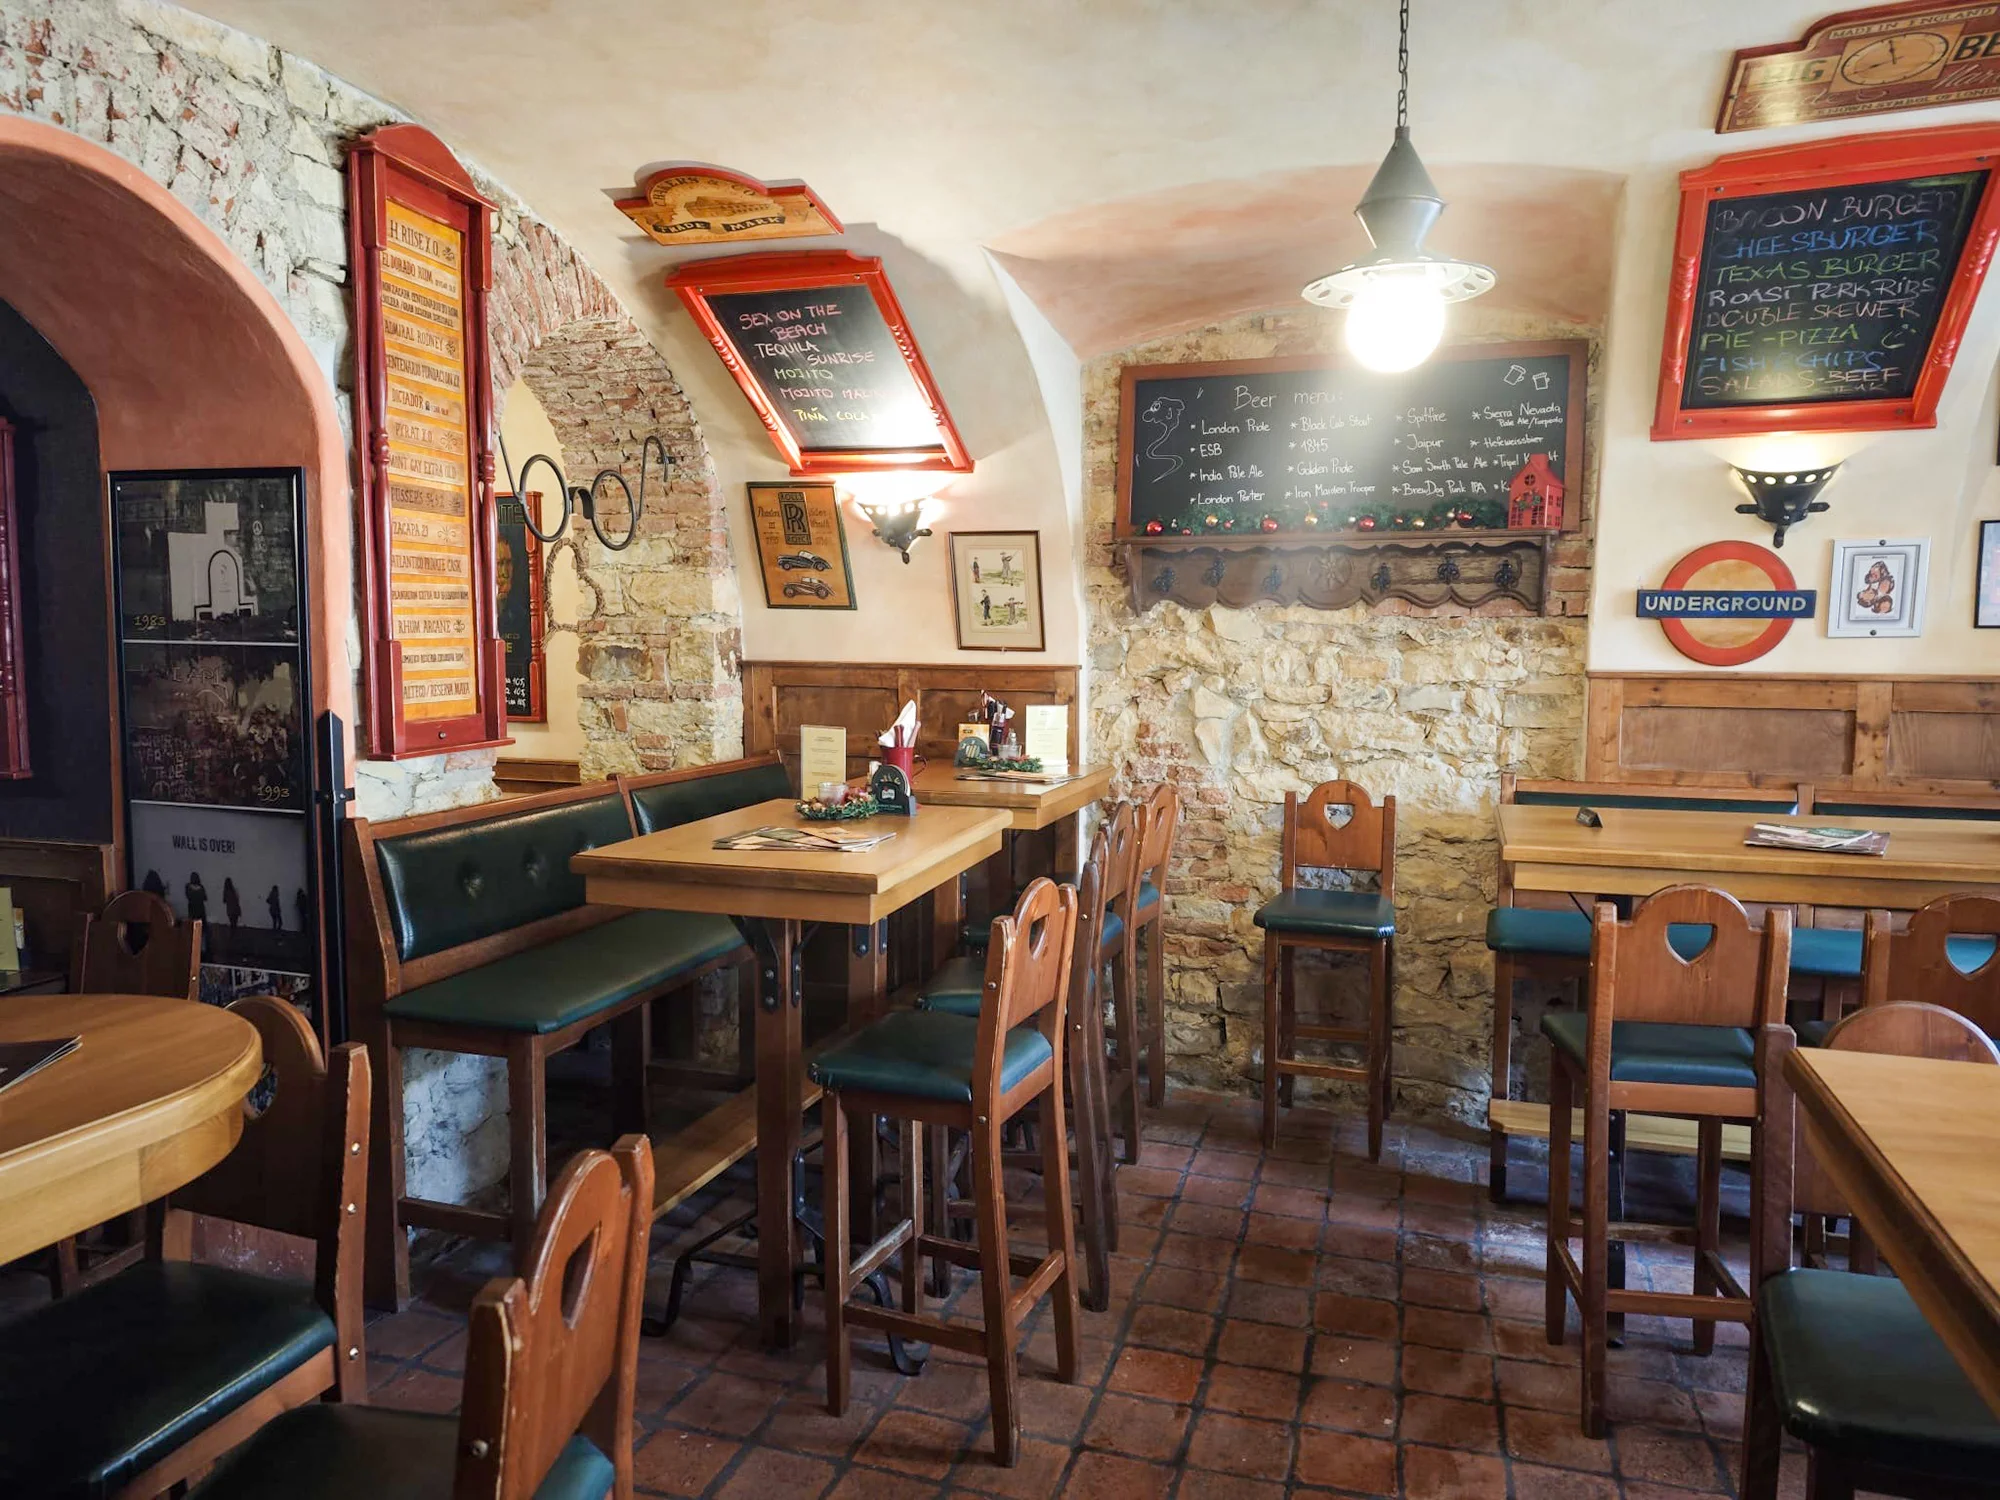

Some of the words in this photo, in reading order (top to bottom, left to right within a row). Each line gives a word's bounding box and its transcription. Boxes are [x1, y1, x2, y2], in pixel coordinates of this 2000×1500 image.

[1832, 26, 1873, 39] MADE
[1877, 22, 1898, 32] IN
[1905, 8, 1993, 26] ENGLAND
[661, 222, 707, 233] TRADE
[730, 216, 781, 231] MARK
[1713, 260, 1813, 286] TEXAS
[1814, 249, 1943, 280] BURGER
[1708, 284, 1802, 308] ROAST
[739, 312, 773, 330] SEX
[776, 308, 802, 321] ON
[804, 304, 842, 319] THE
[1706, 302, 1804, 329] DOUBLE
[1809, 299, 1921, 321] SKEWER
[770, 322, 828, 342] BEACH
[754, 340, 820, 359] TEQUILA
[806, 350, 876, 367] SUNRISE
[1698, 356, 1766, 379] FISH
[1795, 350, 1886, 373] CHIPS
[774, 367, 834, 381] MOJITO
[780, 387, 834, 401] MOJITO
[1234, 385, 1278, 411] Beer
[1407, 406, 1448, 429] Spitfire
[1483, 406, 1513, 419] Sierra
[1519, 402, 1562, 417] Nevada
[1201, 419, 1240, 435] London
[1246, 418, 1271, 432] Pride
[1299, 415, 1328, 432] Black
[1200, 442, 1223, 457] ESB
[1301, 437, 1329, 453] 1845
[1406, 433, 1445, 454] Jaipur
[1199, 468, 1224, 482] India
[1227, 465, 1246, 479] Pale
[1248, 464, 1265, 478] Ale
[1297, 461, 1329, 476] Golden
[1331, 457, 1354, 474] Pride
[1402, 459, 1423, 475] Sam
[1452, 456, 1469, 470] Pale
[1473, 456, 1489, 469] Ale
[1197, 492, 1234, 505] London
[1237, 489, 1266, 503] Porter
[1295, 485, 1312, 499] Iron
[1315, 483, 1346, 497] Maiden
[1402, 480, 1445, 498] BrewDog
[1445, 479, 1468, 494] Punk
[1470, 481, 1487, 494] IPA
[392, 520, 420, 537] ZACAPA
[1644, 595, 1807, 613] UNDERGROUND
[133, 614, 167, 631] 1983
[257, 785, 290, 801] 1993
[172, 835, 197, 851] WALL
[199, 839, 208, 851] IS
[210, 839, 236, 854] OVER!
